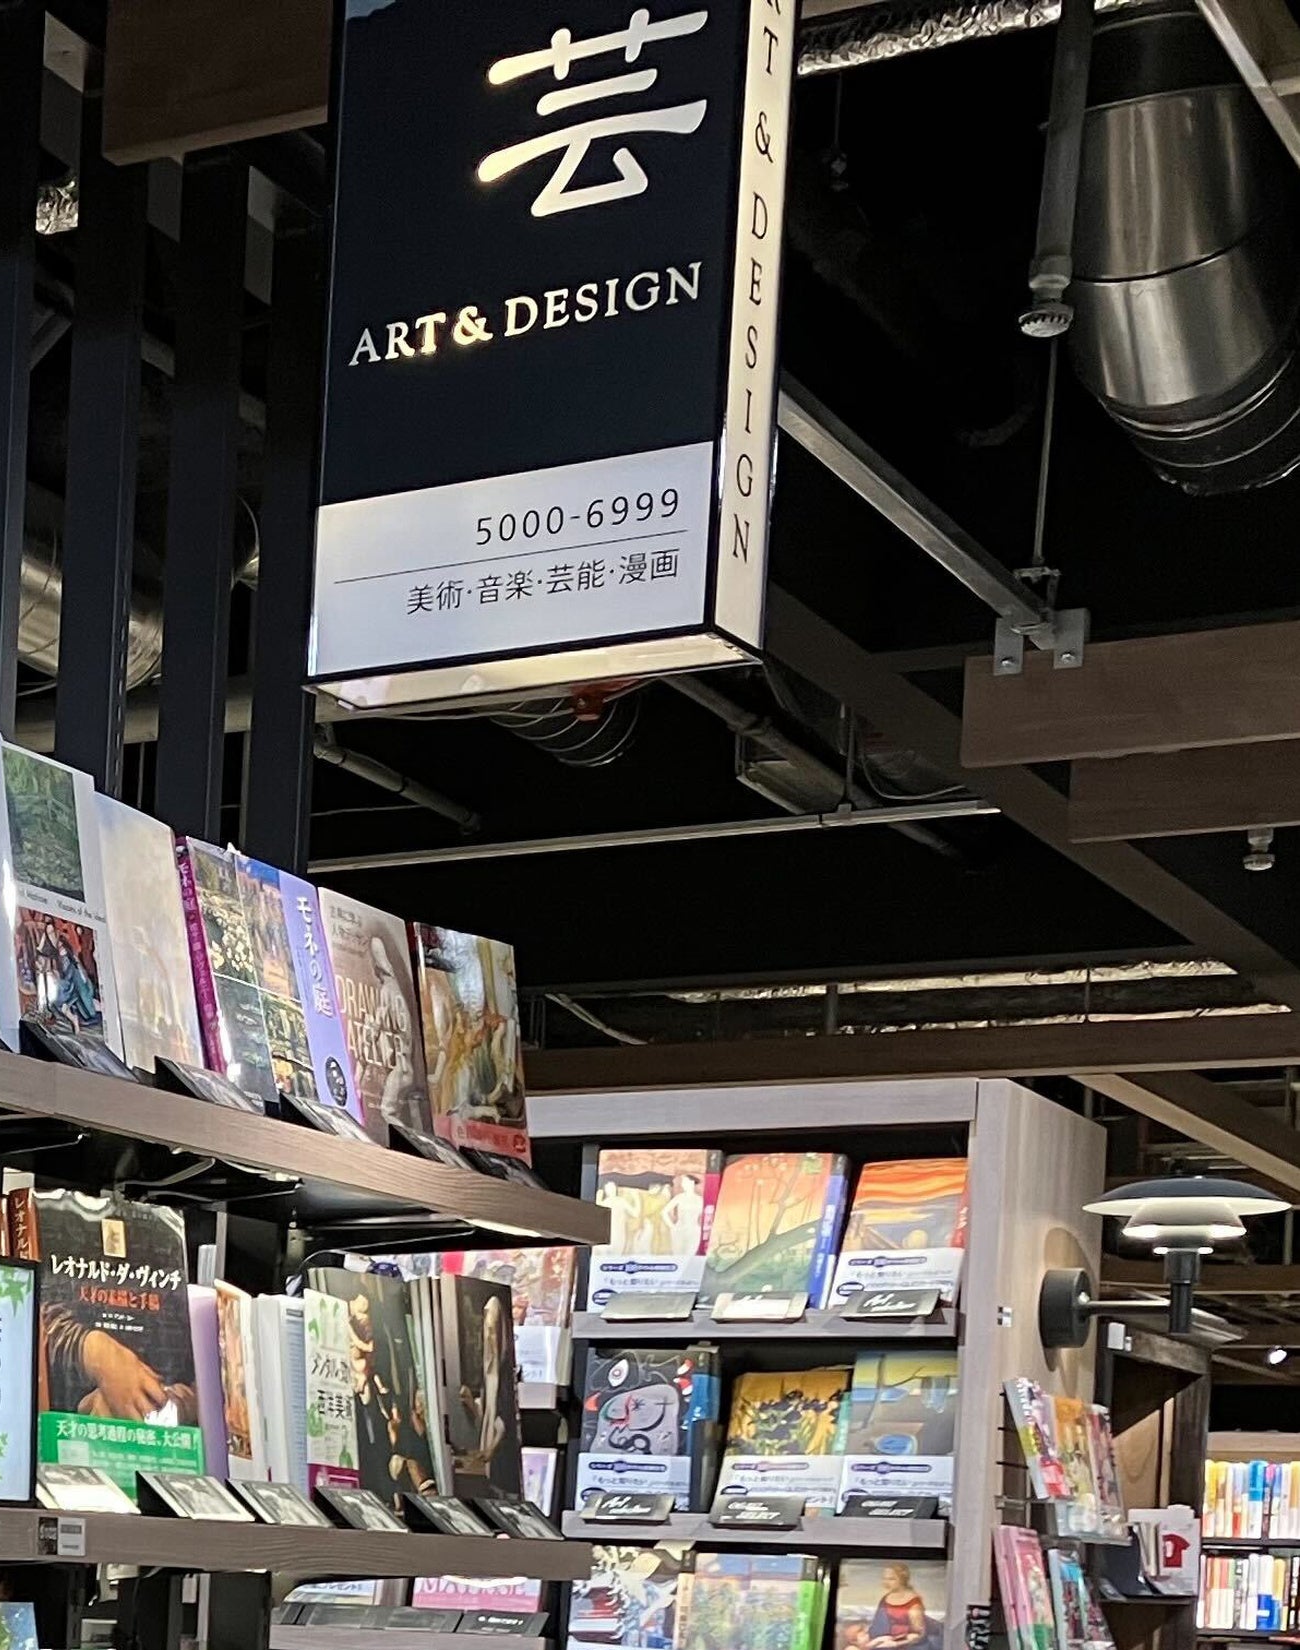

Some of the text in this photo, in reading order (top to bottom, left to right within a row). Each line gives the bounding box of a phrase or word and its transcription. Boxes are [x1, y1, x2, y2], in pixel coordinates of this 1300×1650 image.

[477, 9, 708, 217] 芸
[502, 261, 702, 338] DESIGN
[731, 192, 768, 563] DESIGN
[476, 487, 680, 546] 5000-6999
[296, 897, 336, 1018] モネの庭
[50, 1254, 183, 1291] レオナルド・ダ・ヴィンチ
